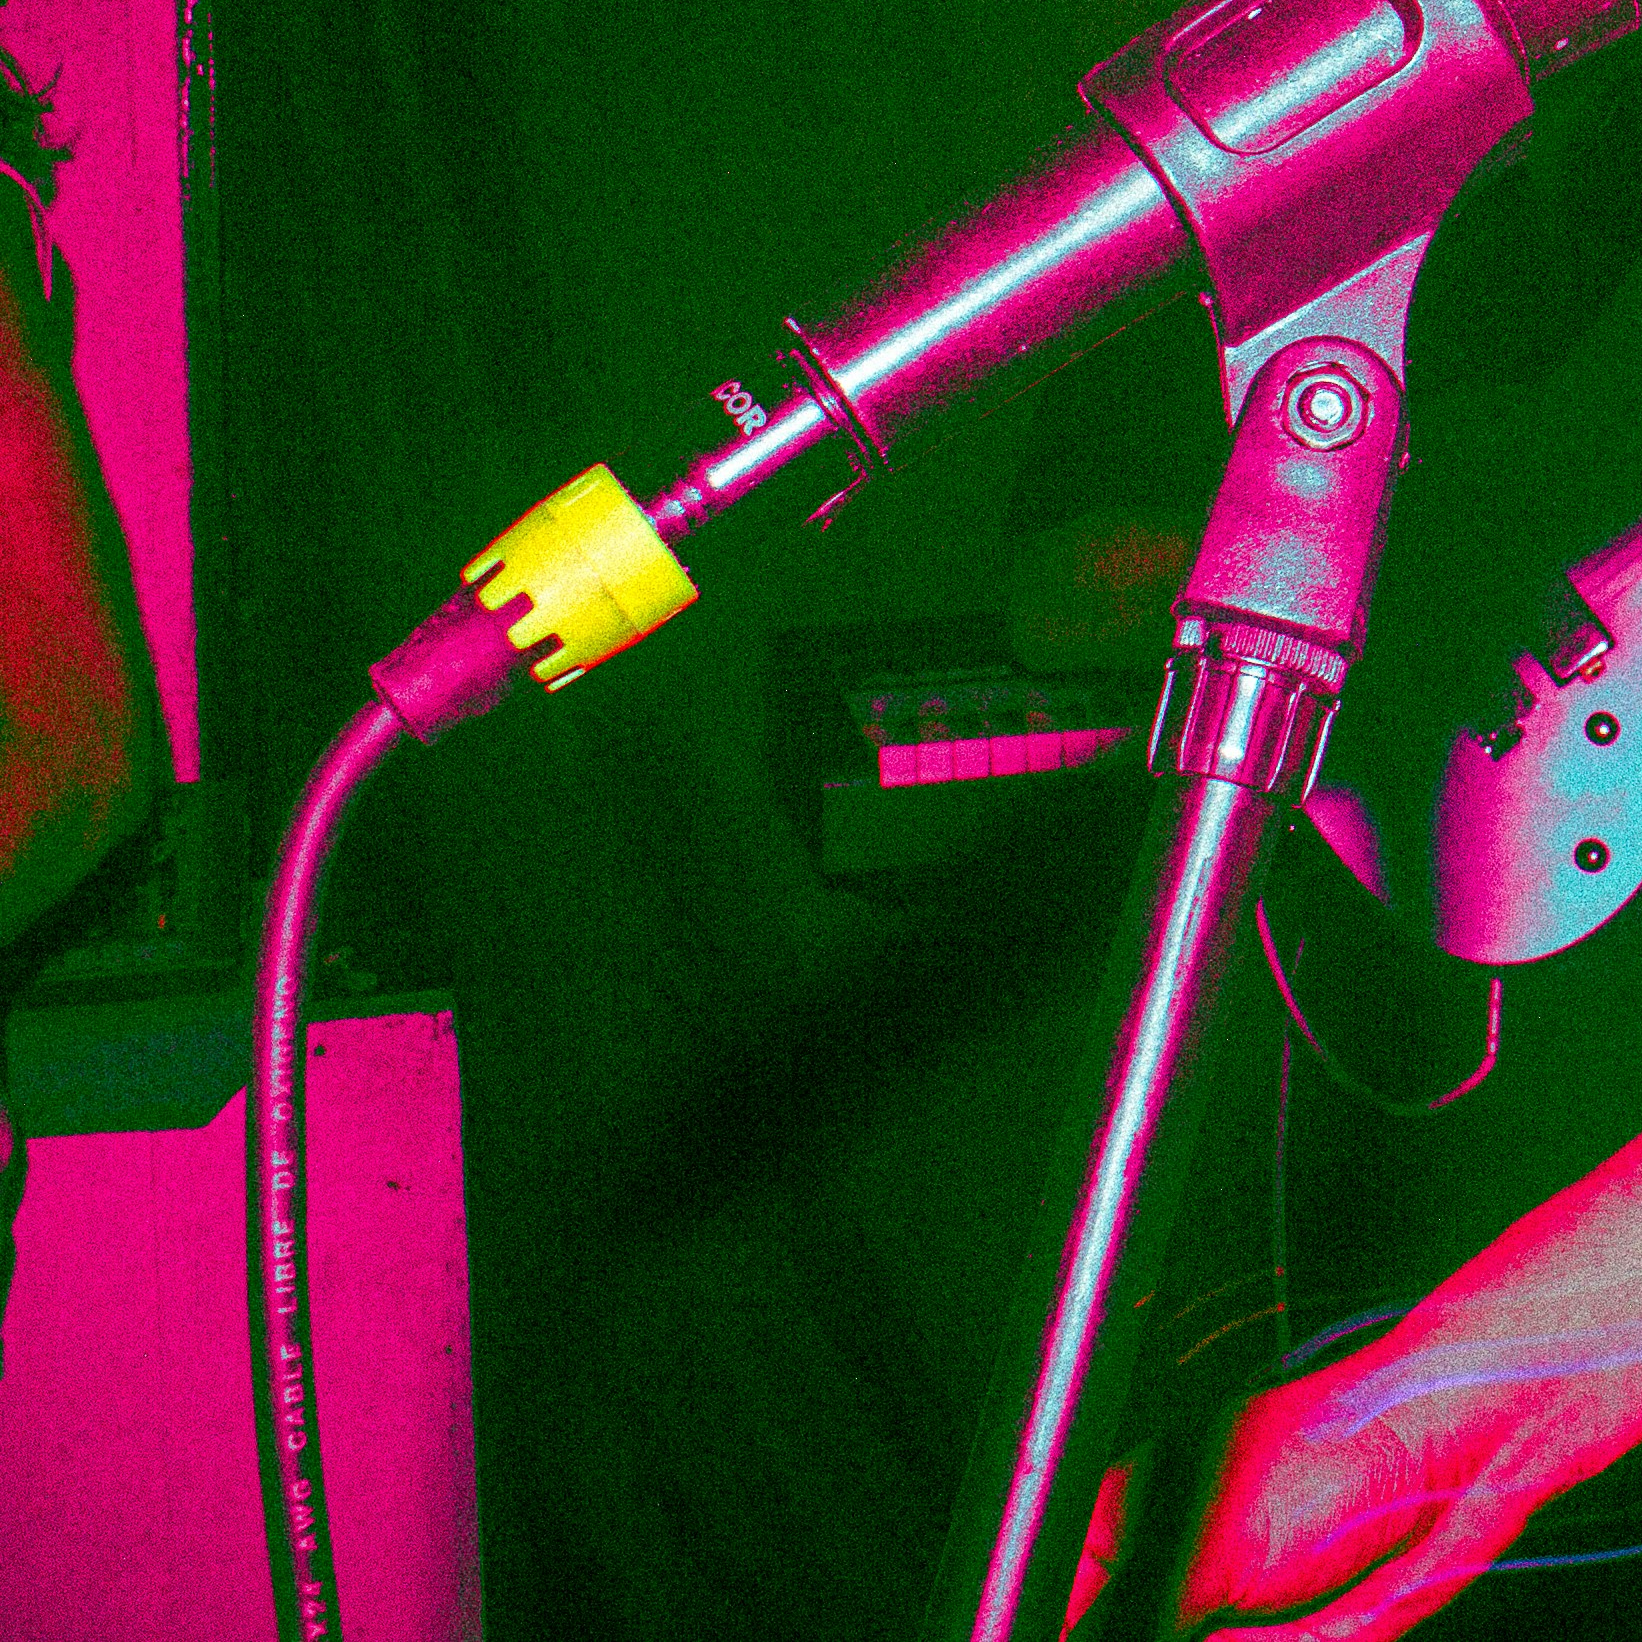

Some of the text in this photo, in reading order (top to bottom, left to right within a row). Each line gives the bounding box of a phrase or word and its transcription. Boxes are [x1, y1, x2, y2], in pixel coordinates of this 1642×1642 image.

[271, 1150, 296, 1190] DE
[271, 1219, 297, 1313] LIBRE
[280, 1343, 308, 1451] CABLE
[291, 1478, 318, 1551] AWG
